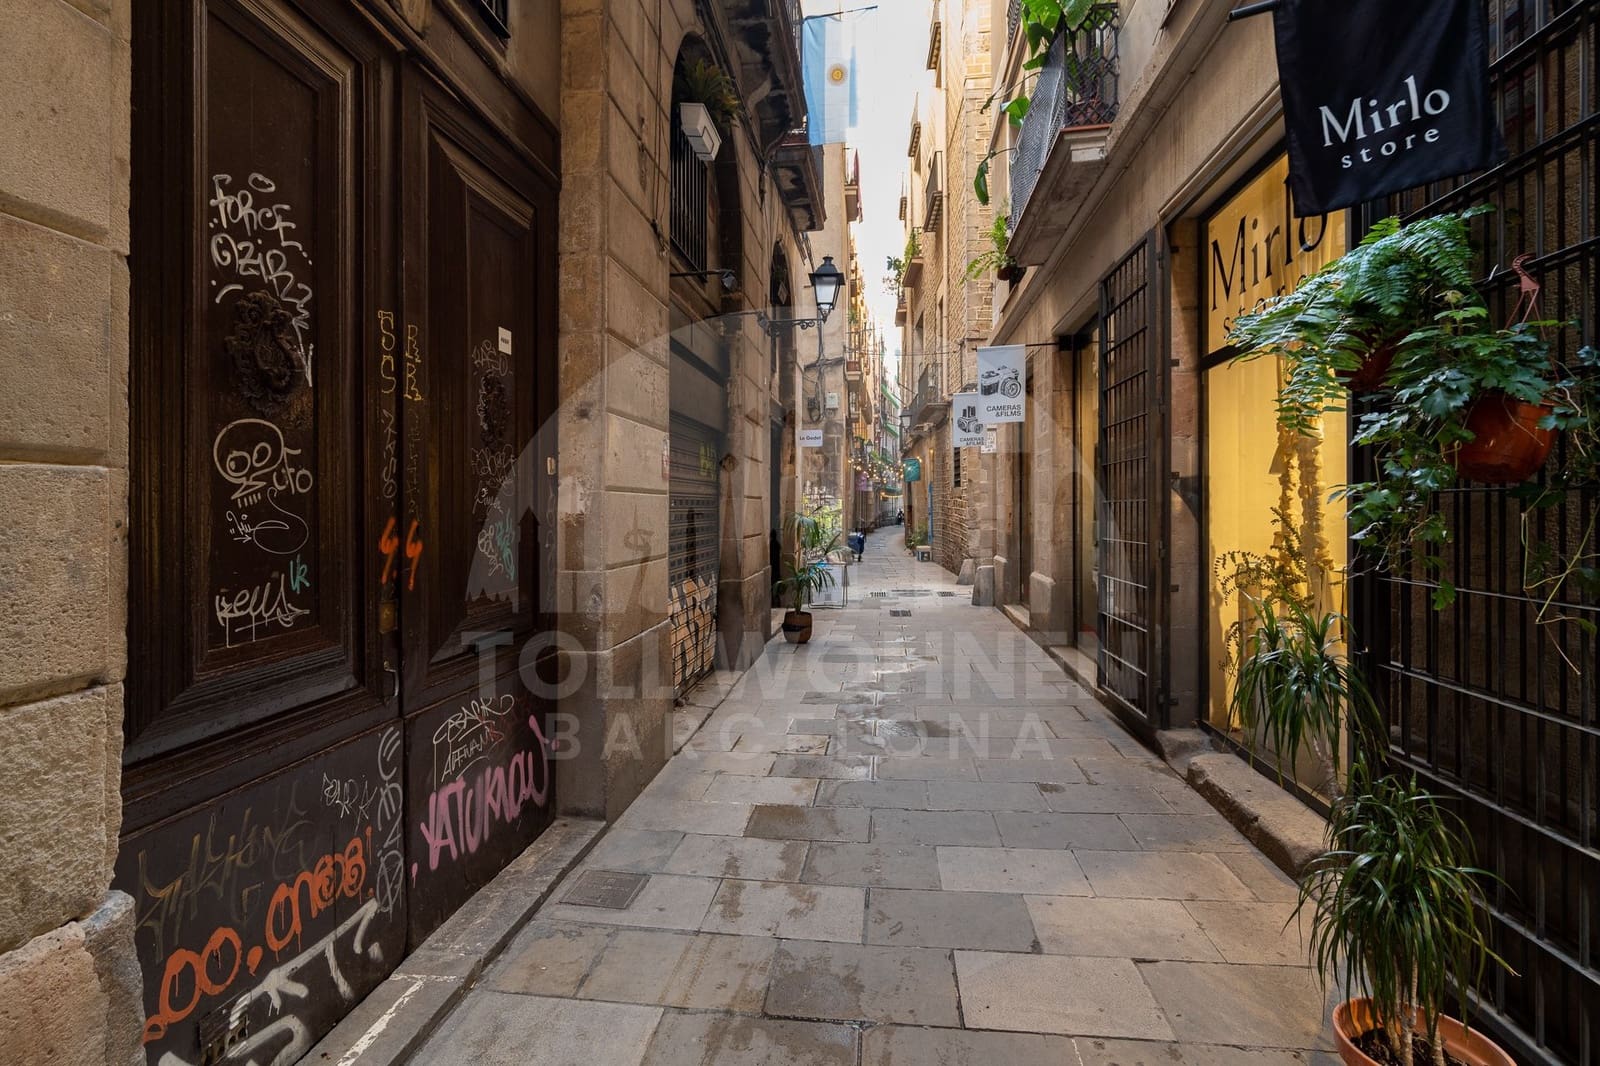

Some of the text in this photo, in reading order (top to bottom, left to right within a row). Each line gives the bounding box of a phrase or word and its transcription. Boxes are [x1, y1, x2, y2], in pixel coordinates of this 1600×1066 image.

[1318, 74, 1451, 147] Mirlo
[1341, 128, 1440, 169] store
[1211, 173, 1328, 312] Mirlo
[986, 404, 1022, 413] CAMERAS
[995, 410, 1022, 418] &FILMS
